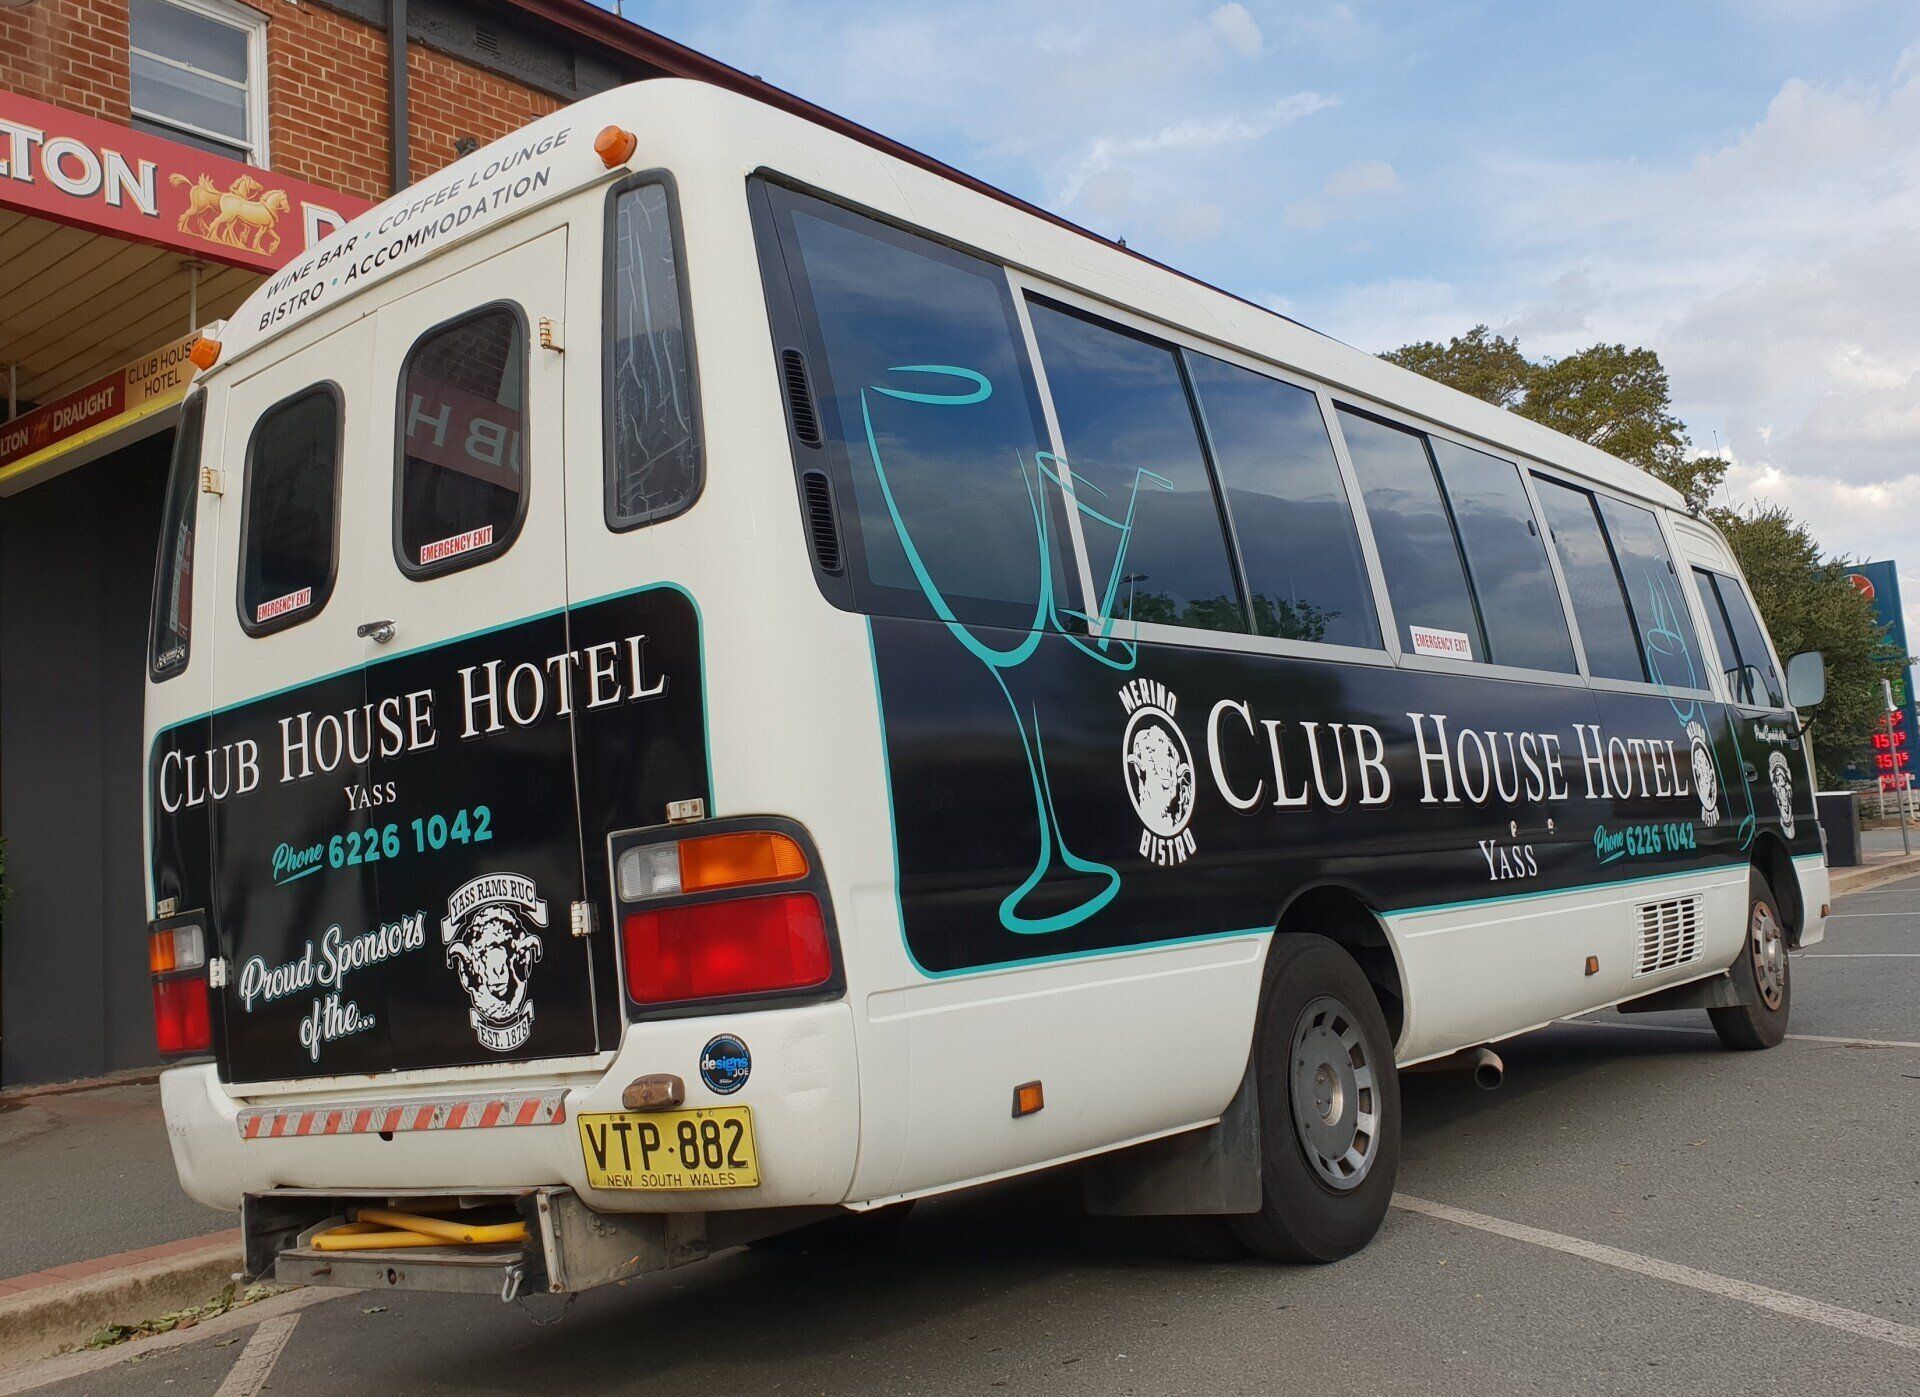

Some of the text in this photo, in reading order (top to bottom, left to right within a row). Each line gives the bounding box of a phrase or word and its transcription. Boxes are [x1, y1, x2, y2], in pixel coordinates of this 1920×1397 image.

[0, 118, 159, 216] TON
[267, 127, 572, 300] WINE BAR COFFEE LOUNGE
[258, 167, 551, 332] BISTRO ACCOMMODATION
[128, 357, 158, 385] CLUB
[144, 369, 182, 398] HOTEL
[52, 387, 115, 433] DRAUGHT
[420, 527, 493, 563] EMERGENCY EXIT
[259, 589, 311, 619] EMERGENCY EXIT
[1415, 633, 1468, 653] EMERGENCY EXIT
[1118, 678, 1177, 717] MERINO
[160, 635, 666, 813] CLUB HOUSE HOTEL
[1207, 699, 1689, 810] CLUB HOUSE HOTEL
[344, 782, 397, 811] YASS
[272, 805, 493, 880] Phone 6226 1042
[1139, 827, 1197, 867] BISTRO
[1478, 839, 1538, 881] YASS
[1594, 822, 1697, 859] Phone 6226 1042
[452, 879, 534, 918] YASS RAMS RUC
[240, 911, 427, 1012] Proud Sponsors
[300, 999, 322, 1062] of
[481, 1021, 528, 1048] EST. 1878
[701, 1053, 749, 1071] designs
[733, 1067, 749, 1077] JOE
[607, 1172, 736, 1187] NEW SOUTH WALES
